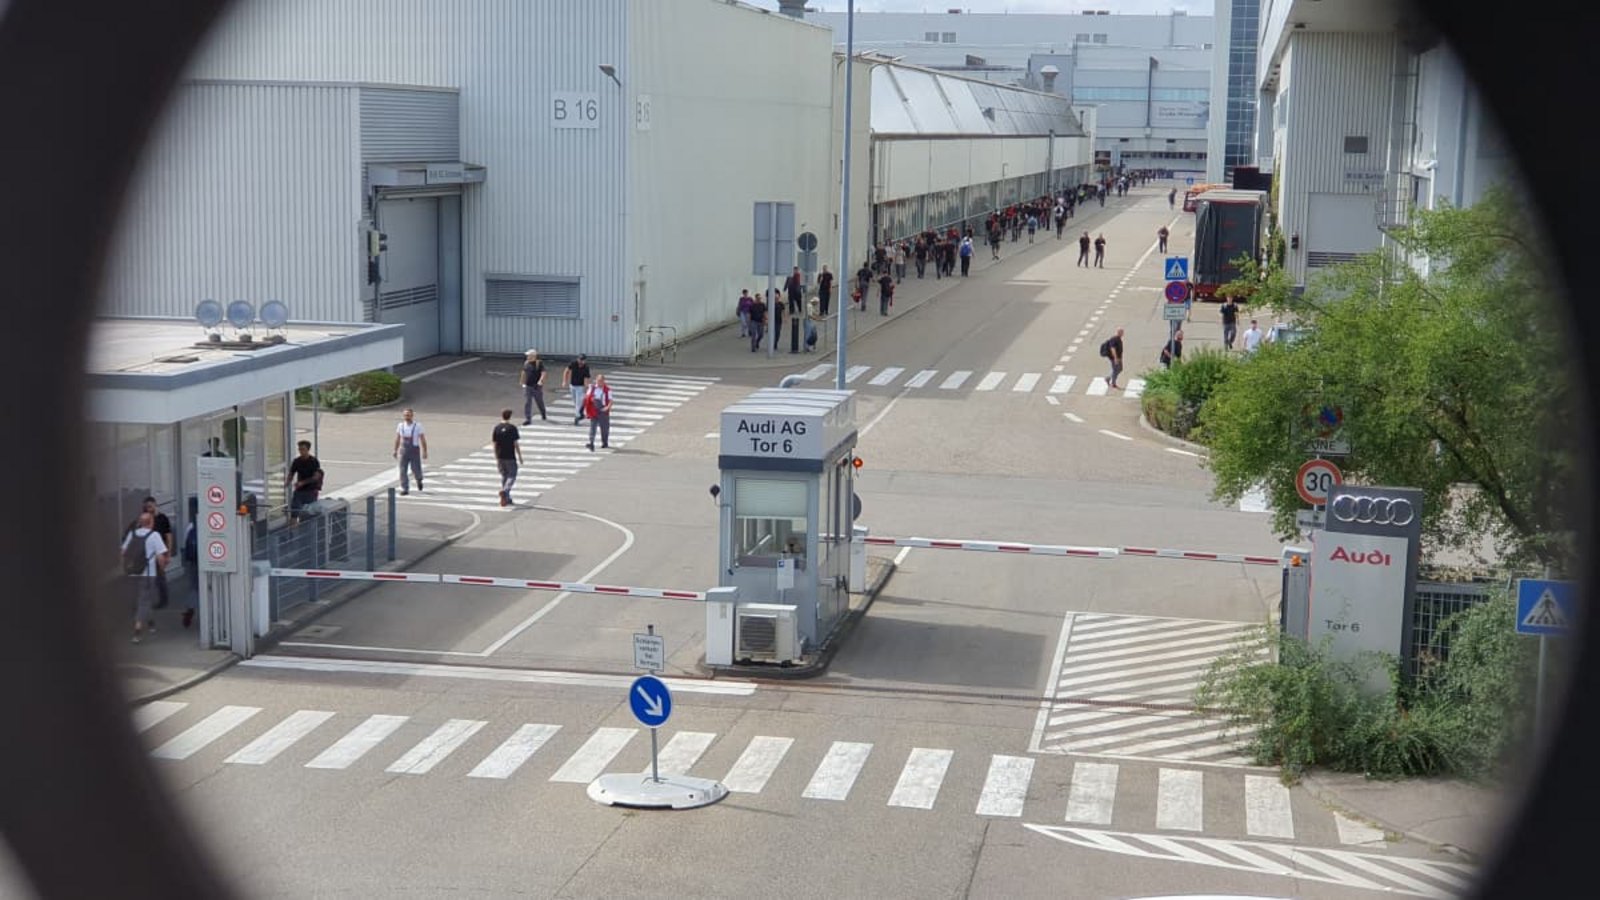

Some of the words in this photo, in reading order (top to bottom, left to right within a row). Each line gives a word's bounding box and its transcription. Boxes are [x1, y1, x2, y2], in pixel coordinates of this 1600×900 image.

[554, 99, 567, 120] B
[576, 99, 597, 121] 16
[737, 419, 776, 434] Audi
[780, 420, 807, 436] AG
[750, 437, 778, 453] Tor
[783, 439, 793, 453] 6
[1306, 471, 1332, 493] 30
[1330, 546, 1391, 566] Audi
[1325, 619, 1348, 631] Tor
[1351, 622, 1361, 633] 6
